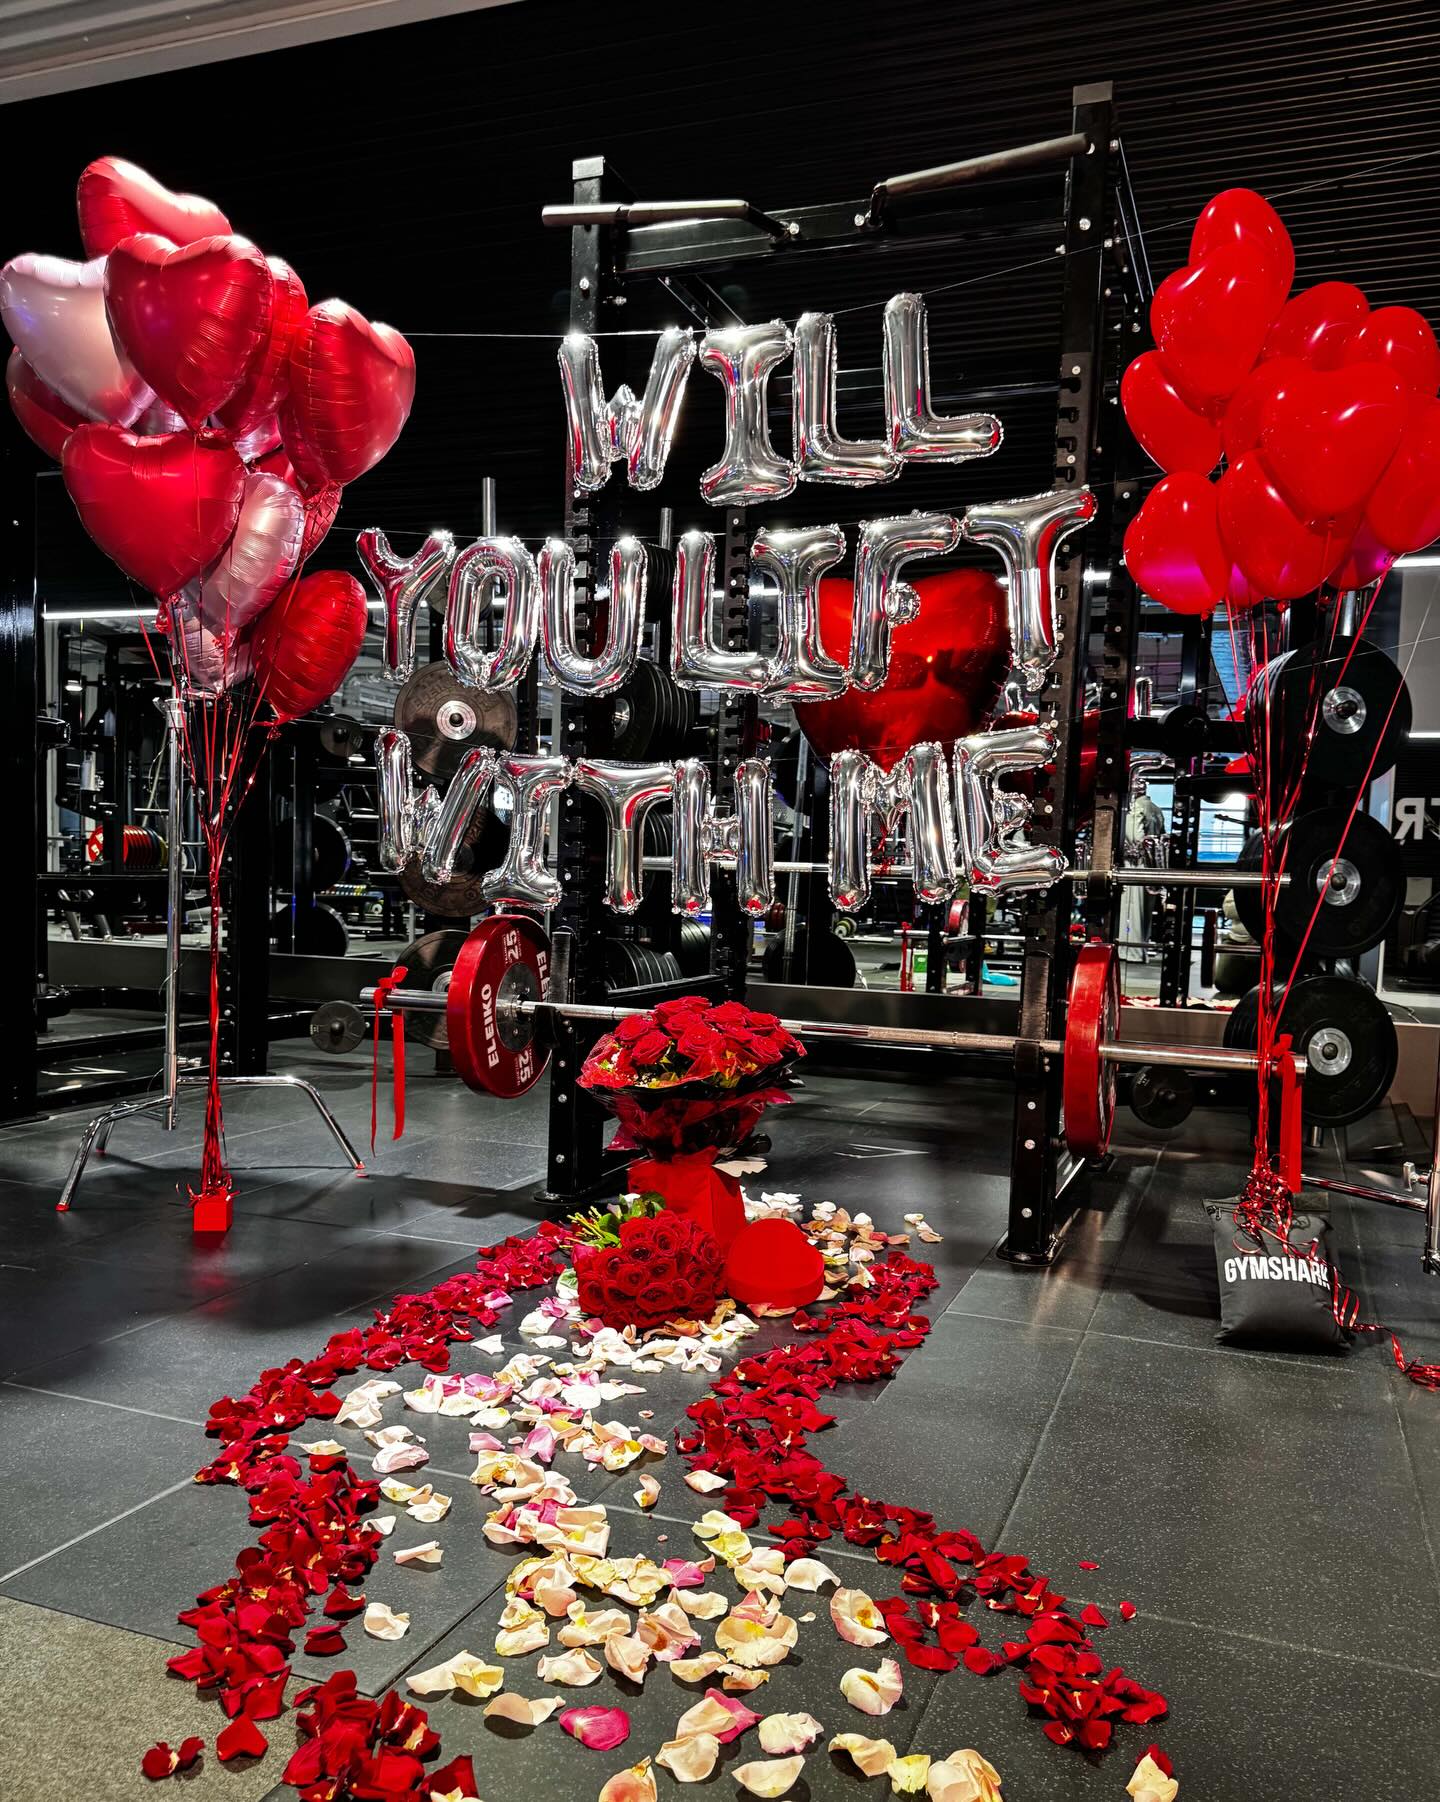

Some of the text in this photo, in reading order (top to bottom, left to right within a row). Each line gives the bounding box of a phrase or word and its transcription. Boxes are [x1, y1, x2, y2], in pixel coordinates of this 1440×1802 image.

[558, 293, 1004, 506] WILL
[357, 486, 1098, 704] YOU LIFT
[375, 724, 1069, 915] WITH ME
[506, 930, 519, 963] 25
[536, 950, 551, 1001] ELE
[481, 983, 500, 1068] ELEIKO
[518, 1050, 531, 1083] 25
[1224, 1256, 1330, 1290] GYMSHARK
